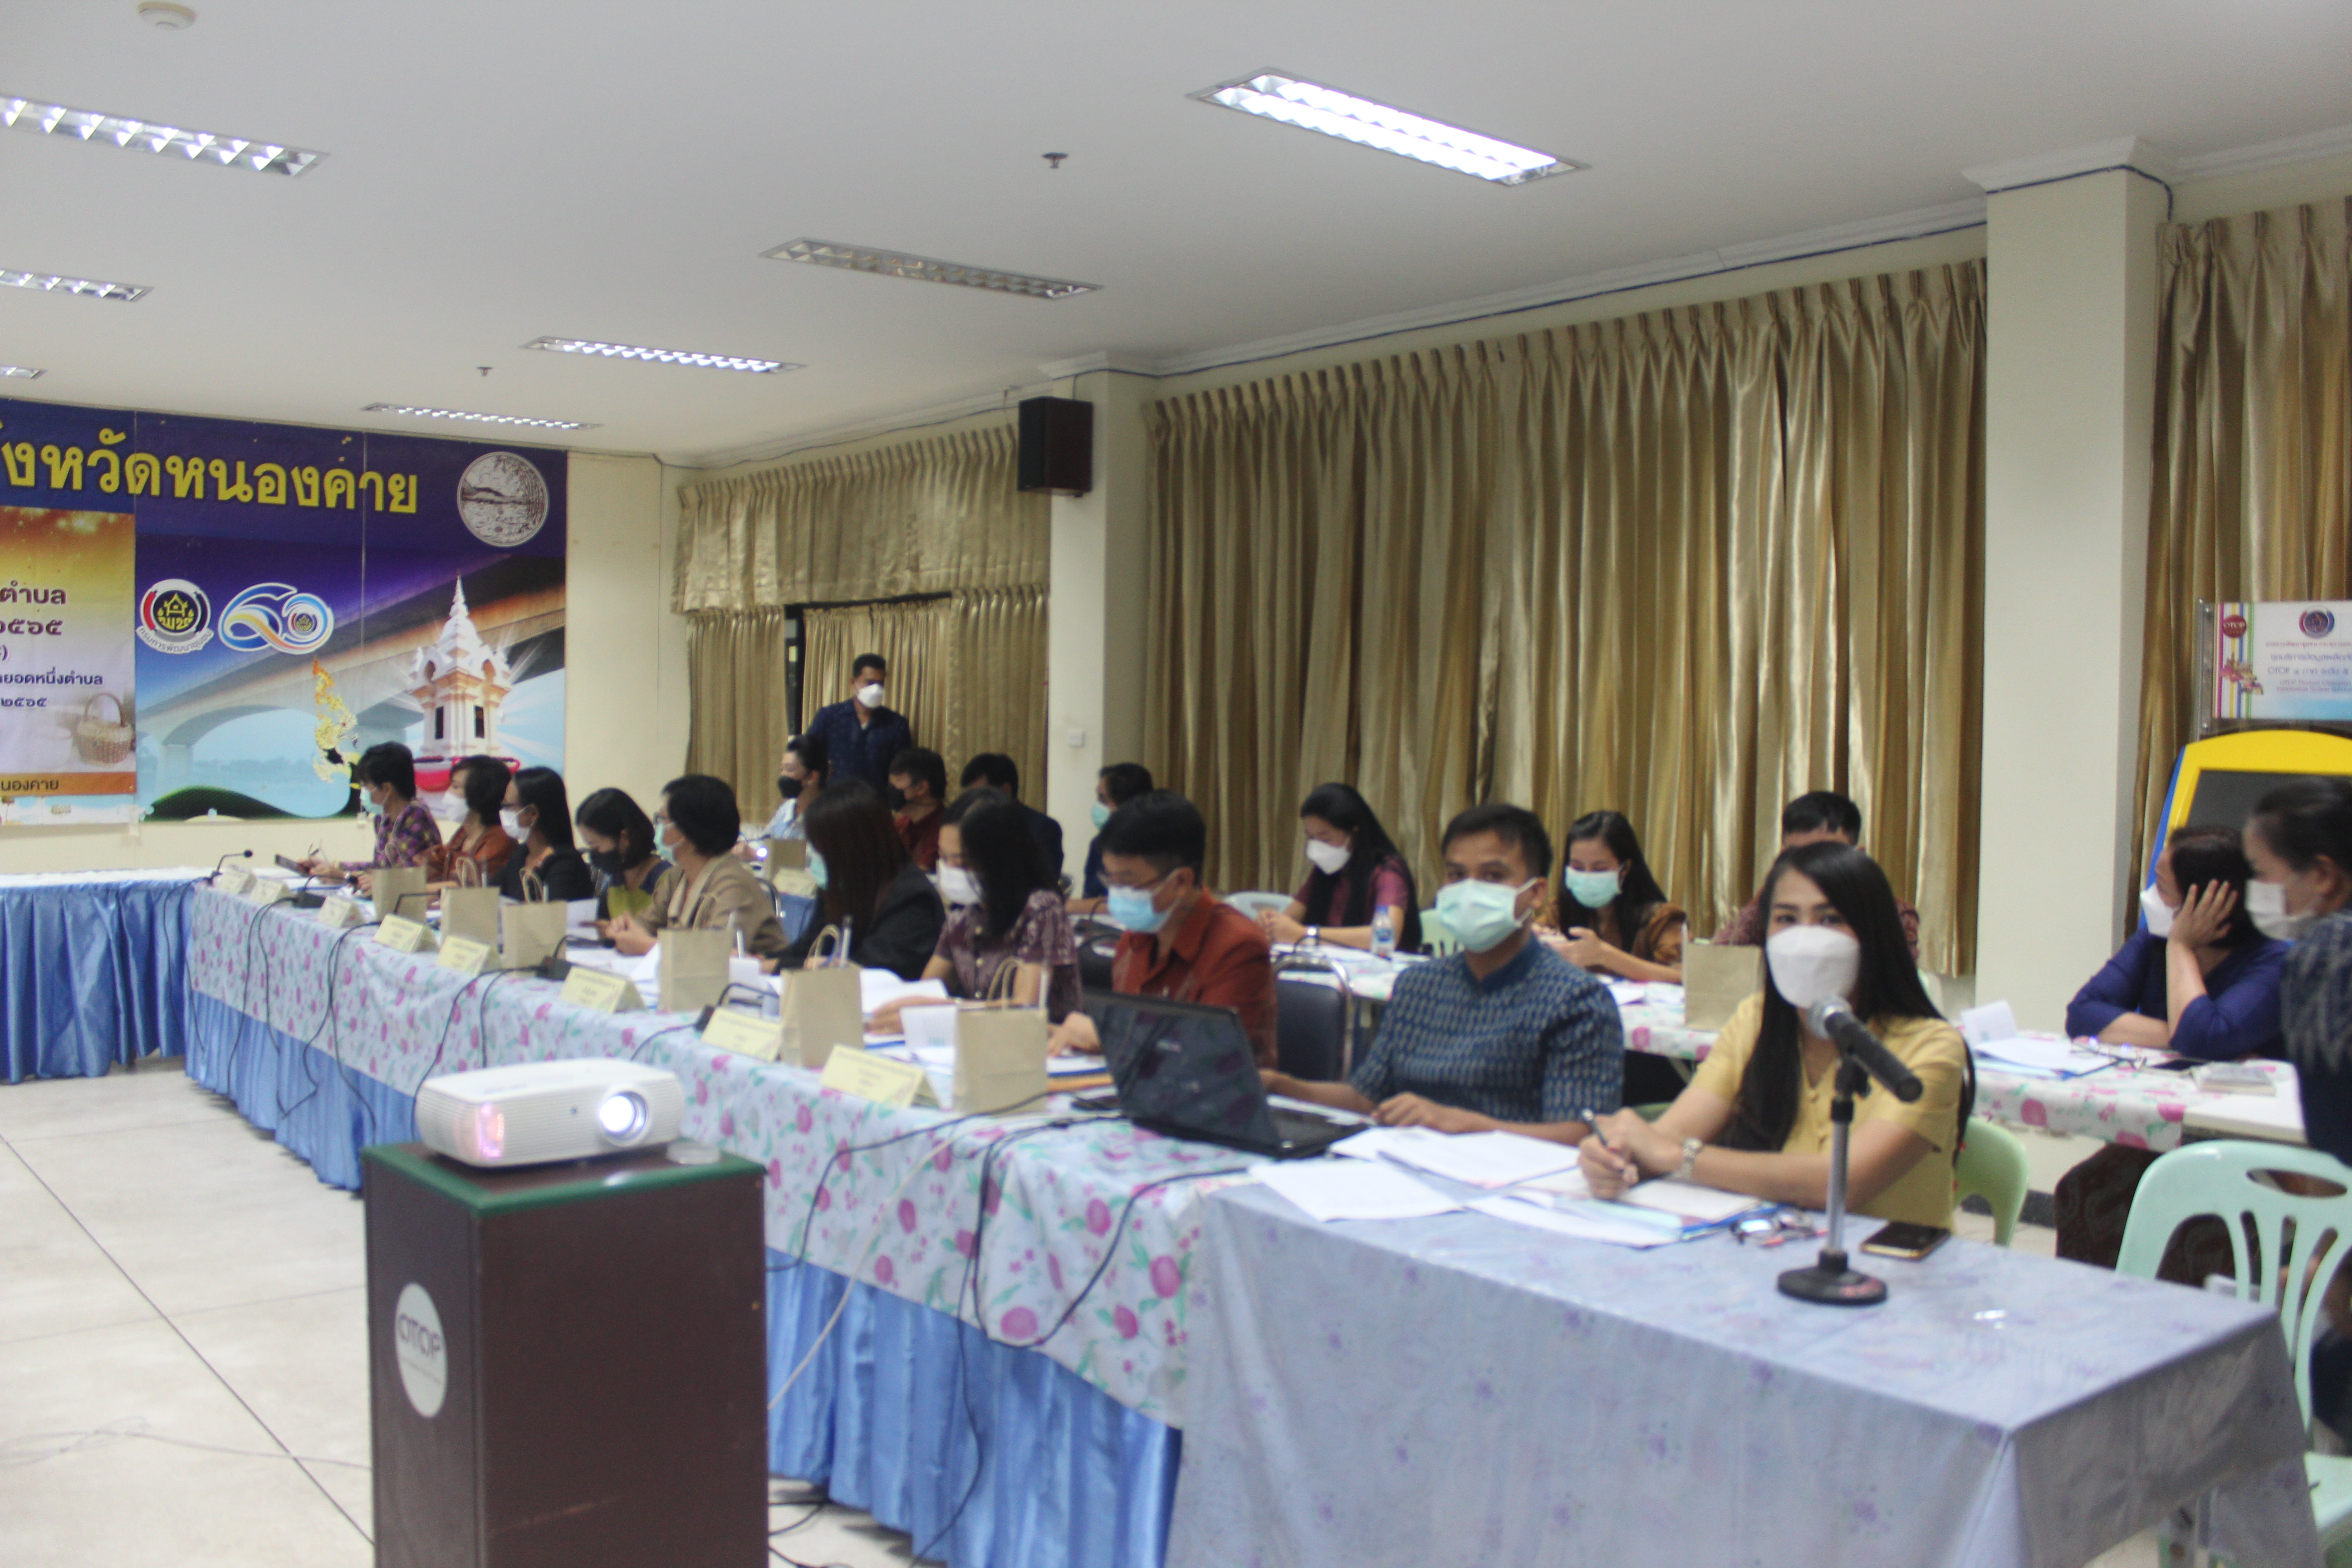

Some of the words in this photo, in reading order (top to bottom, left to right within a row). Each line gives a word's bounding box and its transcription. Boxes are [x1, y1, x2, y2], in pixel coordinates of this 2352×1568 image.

[0, 421, 418, 514] งหวัดหนองคาย
[0, 580, 66, 605] ตำบล
[399, 1314, 441, 1358] OTOP
